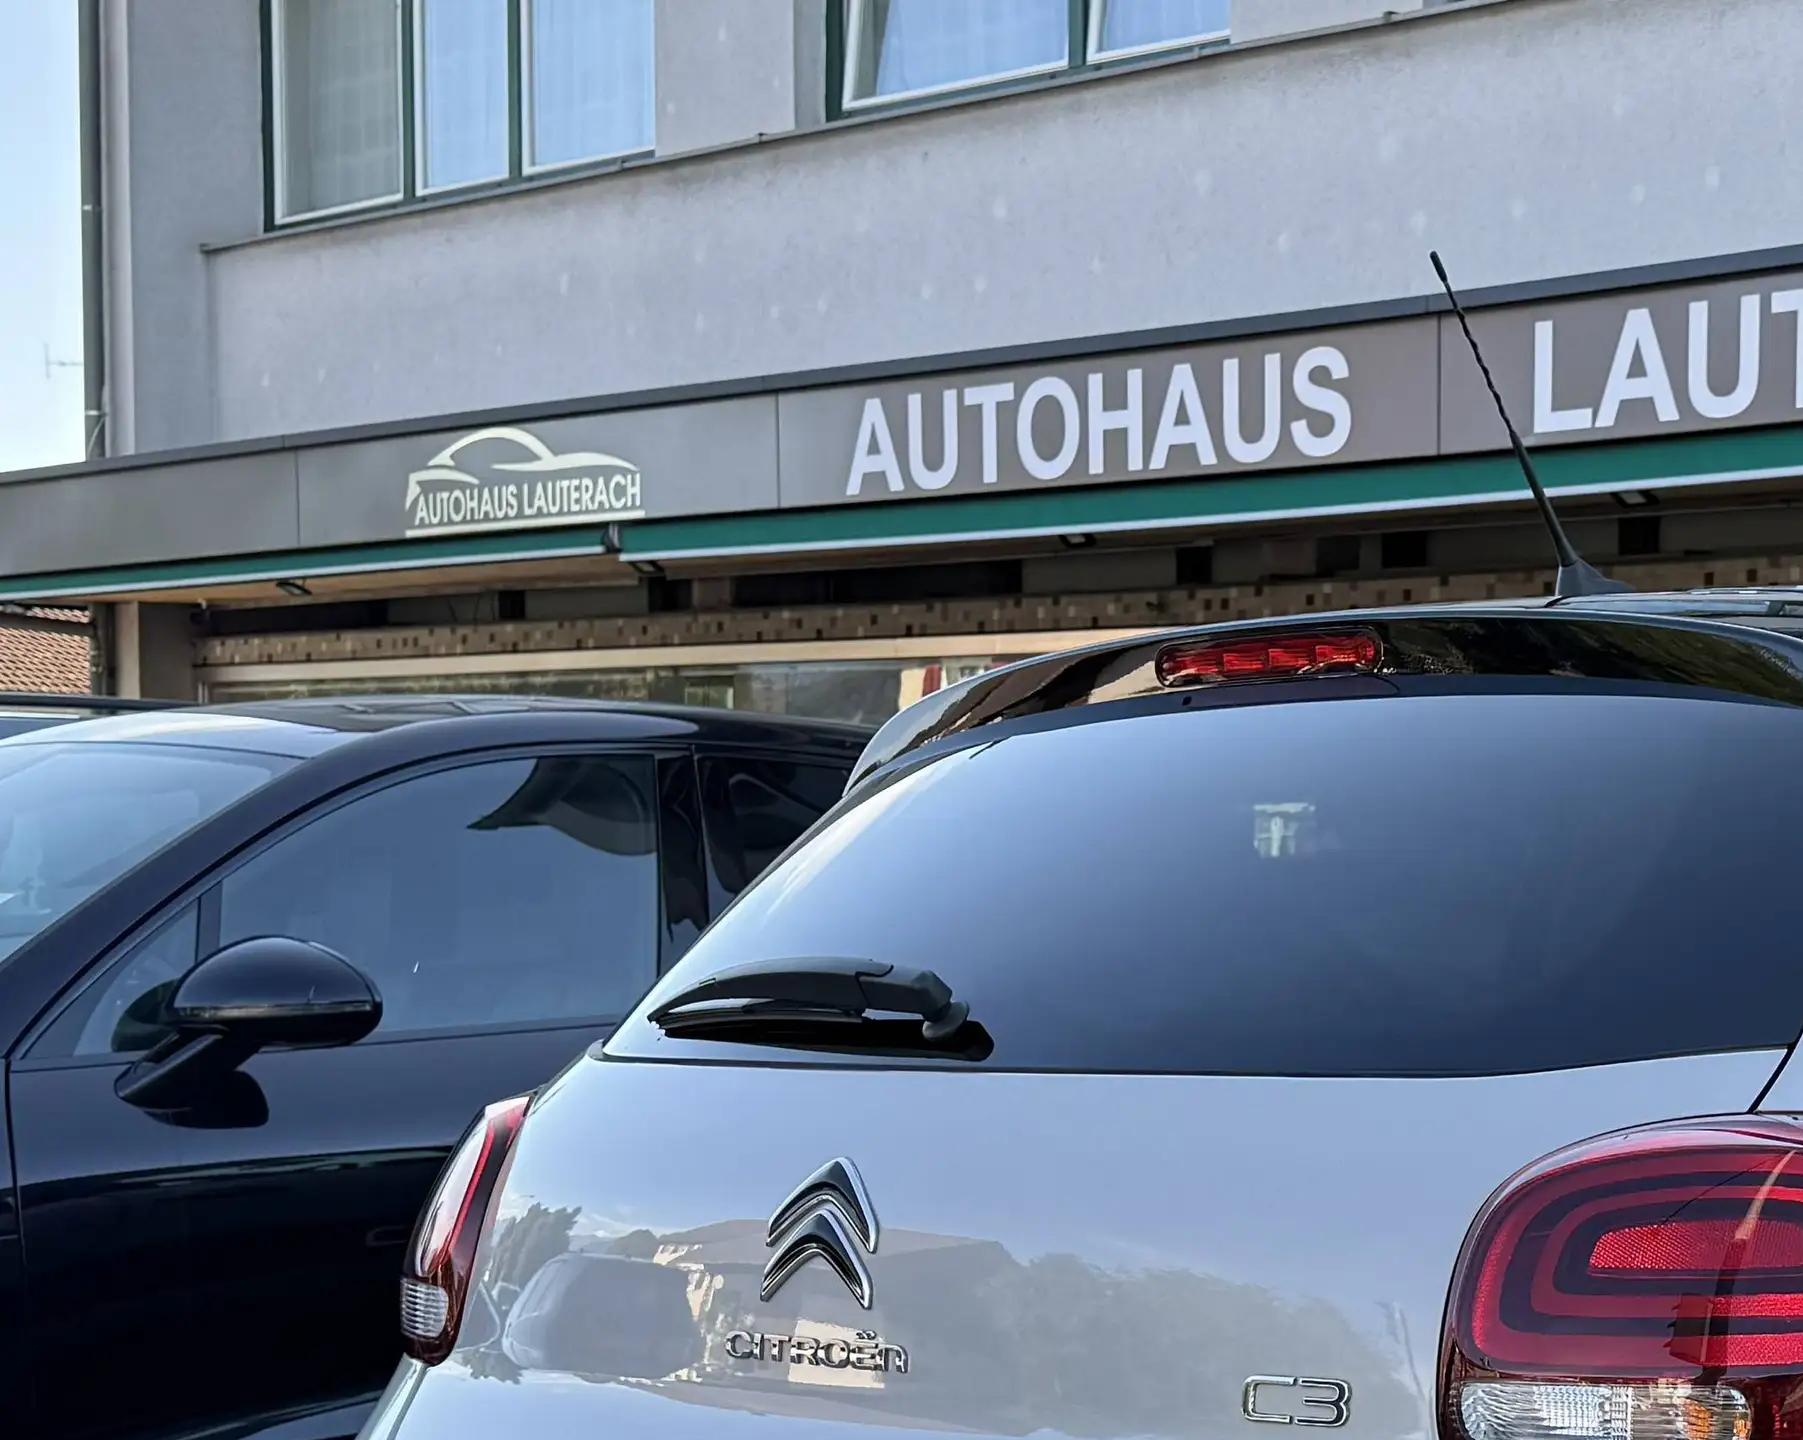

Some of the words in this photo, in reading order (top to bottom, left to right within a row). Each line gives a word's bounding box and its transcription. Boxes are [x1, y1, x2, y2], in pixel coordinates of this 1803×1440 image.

[845, 345, 1352, 497] AUTOHAUS
[414, 484, 518, 525] AUTOHAUS
[522, 472, 641, 516] LAUTERACH
[1241, 1373, 1353, 1428] C3
